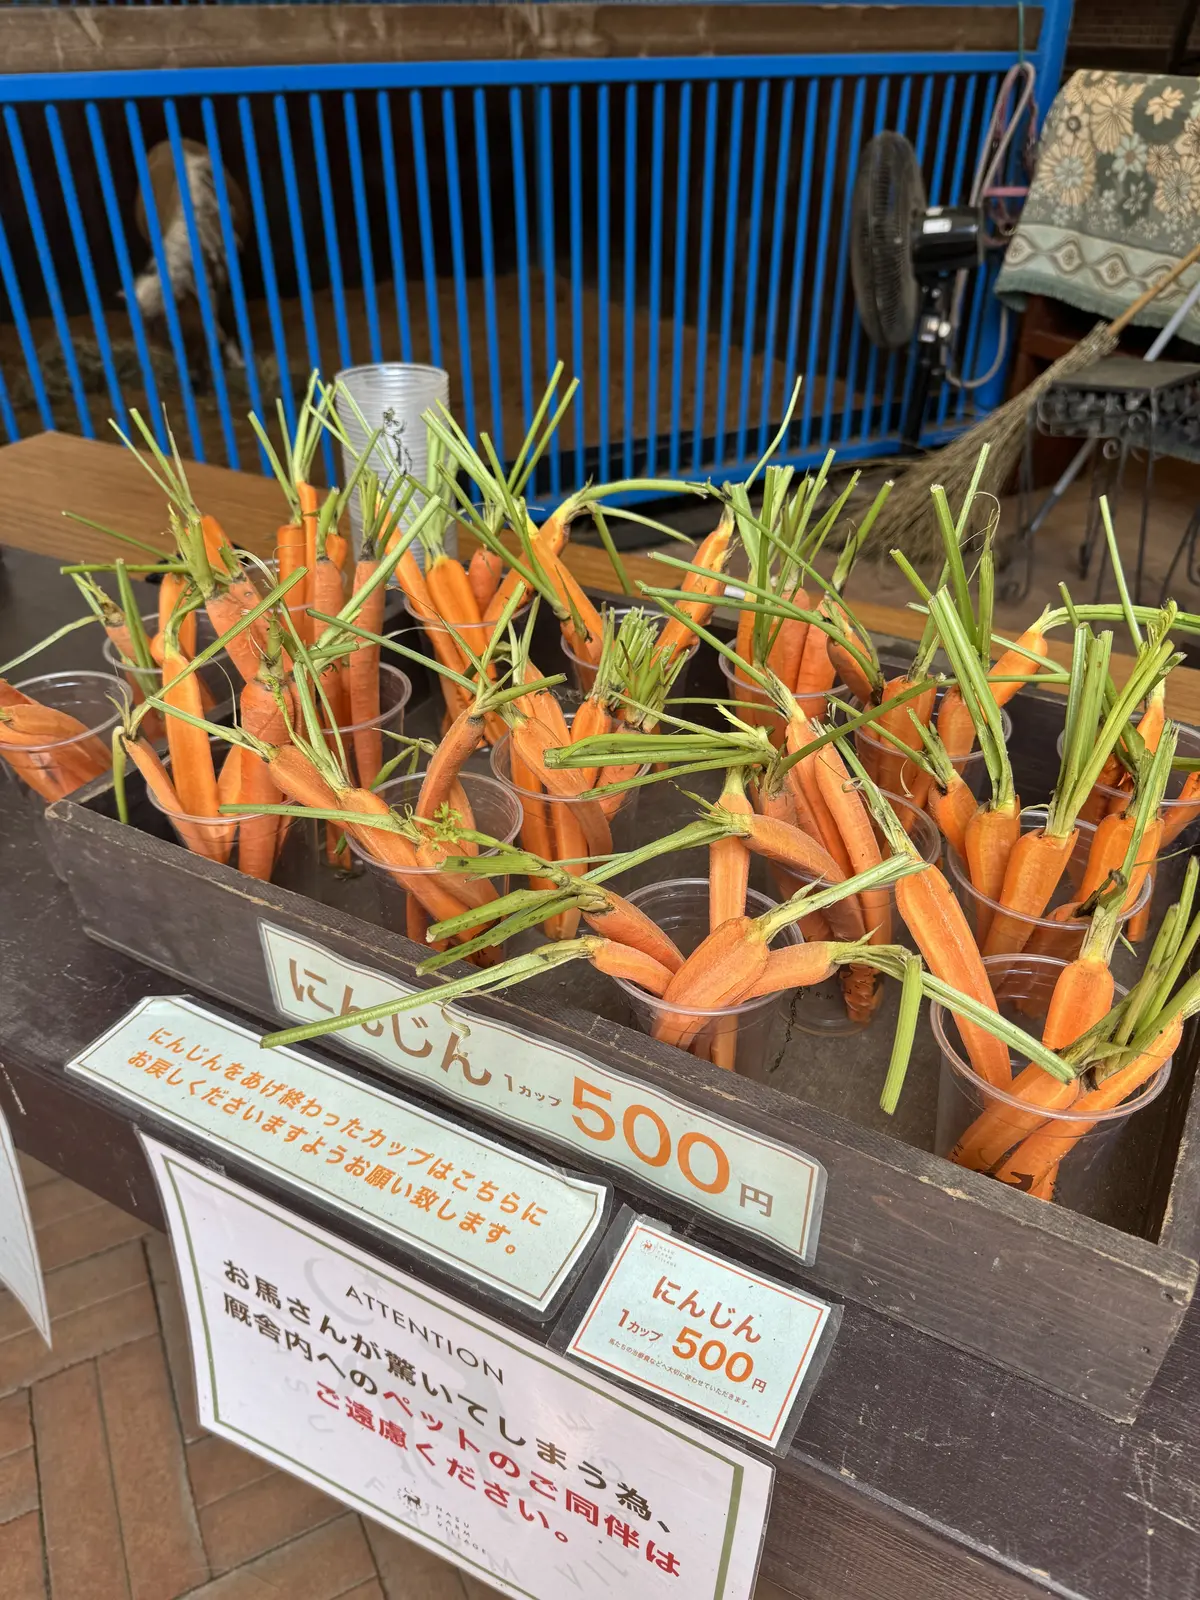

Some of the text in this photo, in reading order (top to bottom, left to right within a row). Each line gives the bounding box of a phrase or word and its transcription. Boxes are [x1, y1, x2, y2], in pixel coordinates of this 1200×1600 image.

[289, 958, 492, 1086] にんじん
[128, 1050, 516, 1255] お戻しくださいますようお願い致します。
[148, 1027, 548, 1226] にんじんをあげ終わったカップはこちらに
[346, 1285, 503, 1385] ATTENTION
[652, 1275, 761, 1343] にんじん
[223, 1259, 670, 1533] お馬さんが驚いてしまう為、
[317, 1381, 568, 1543] ご遠慮ください。
